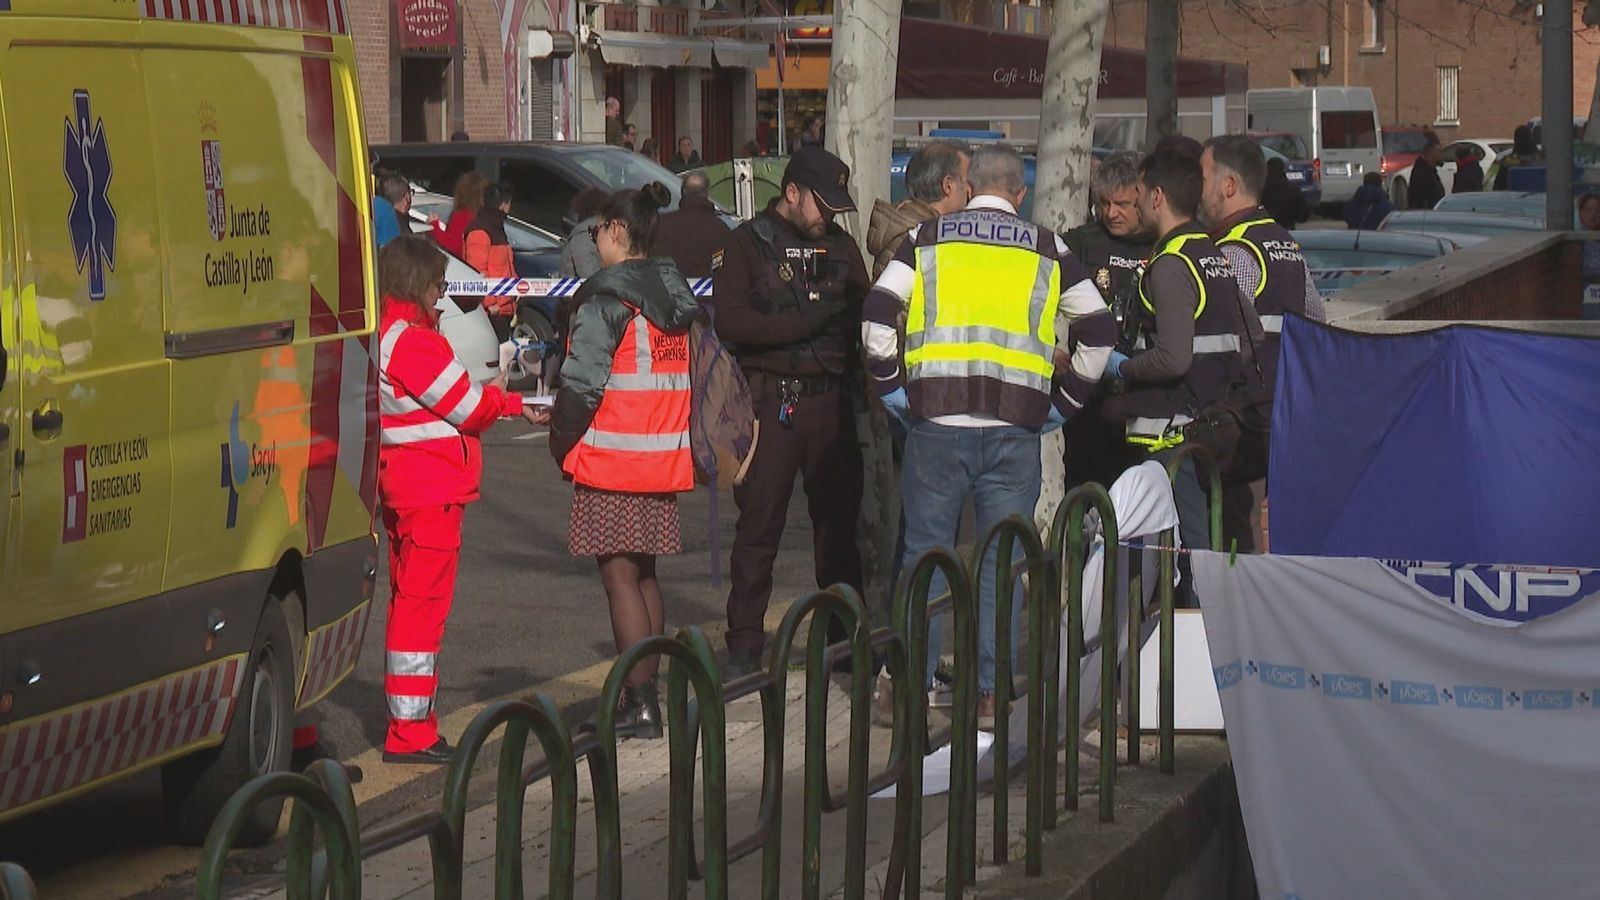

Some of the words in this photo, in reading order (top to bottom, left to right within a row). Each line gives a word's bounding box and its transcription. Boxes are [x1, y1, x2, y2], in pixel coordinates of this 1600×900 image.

[405, 11, 449, 23] servicio
[993, 68, 1018, 88] Café
[1029, 68, 1044, 83] Ba
[230, 204, 257, 238] Junta
[258, 202, 271, 236] de
[941, 222, 1033, 246] POLICIA
[205, 251, 241, 287] Castilla
[242, 258, 248, 295] y
[250, 248, 274, 282] León
[448, 281, 460, 292] LOC
[463, 281, 487, 292] POLICIA
[89, 442, 122, 468] CASTILLA
[122, 440, 129, 462] Y
[129, 433, 148, 461] LEÓN
[251, 440, 276, 486] Sacyl
[91, 472, 141, 502] EMERGENCIAS
[89, 506, 132, 536] SANITARIAS
[1266, 667, 1297, 684] Sacyl
[1331, 677, 1364, 696] Sacyl
